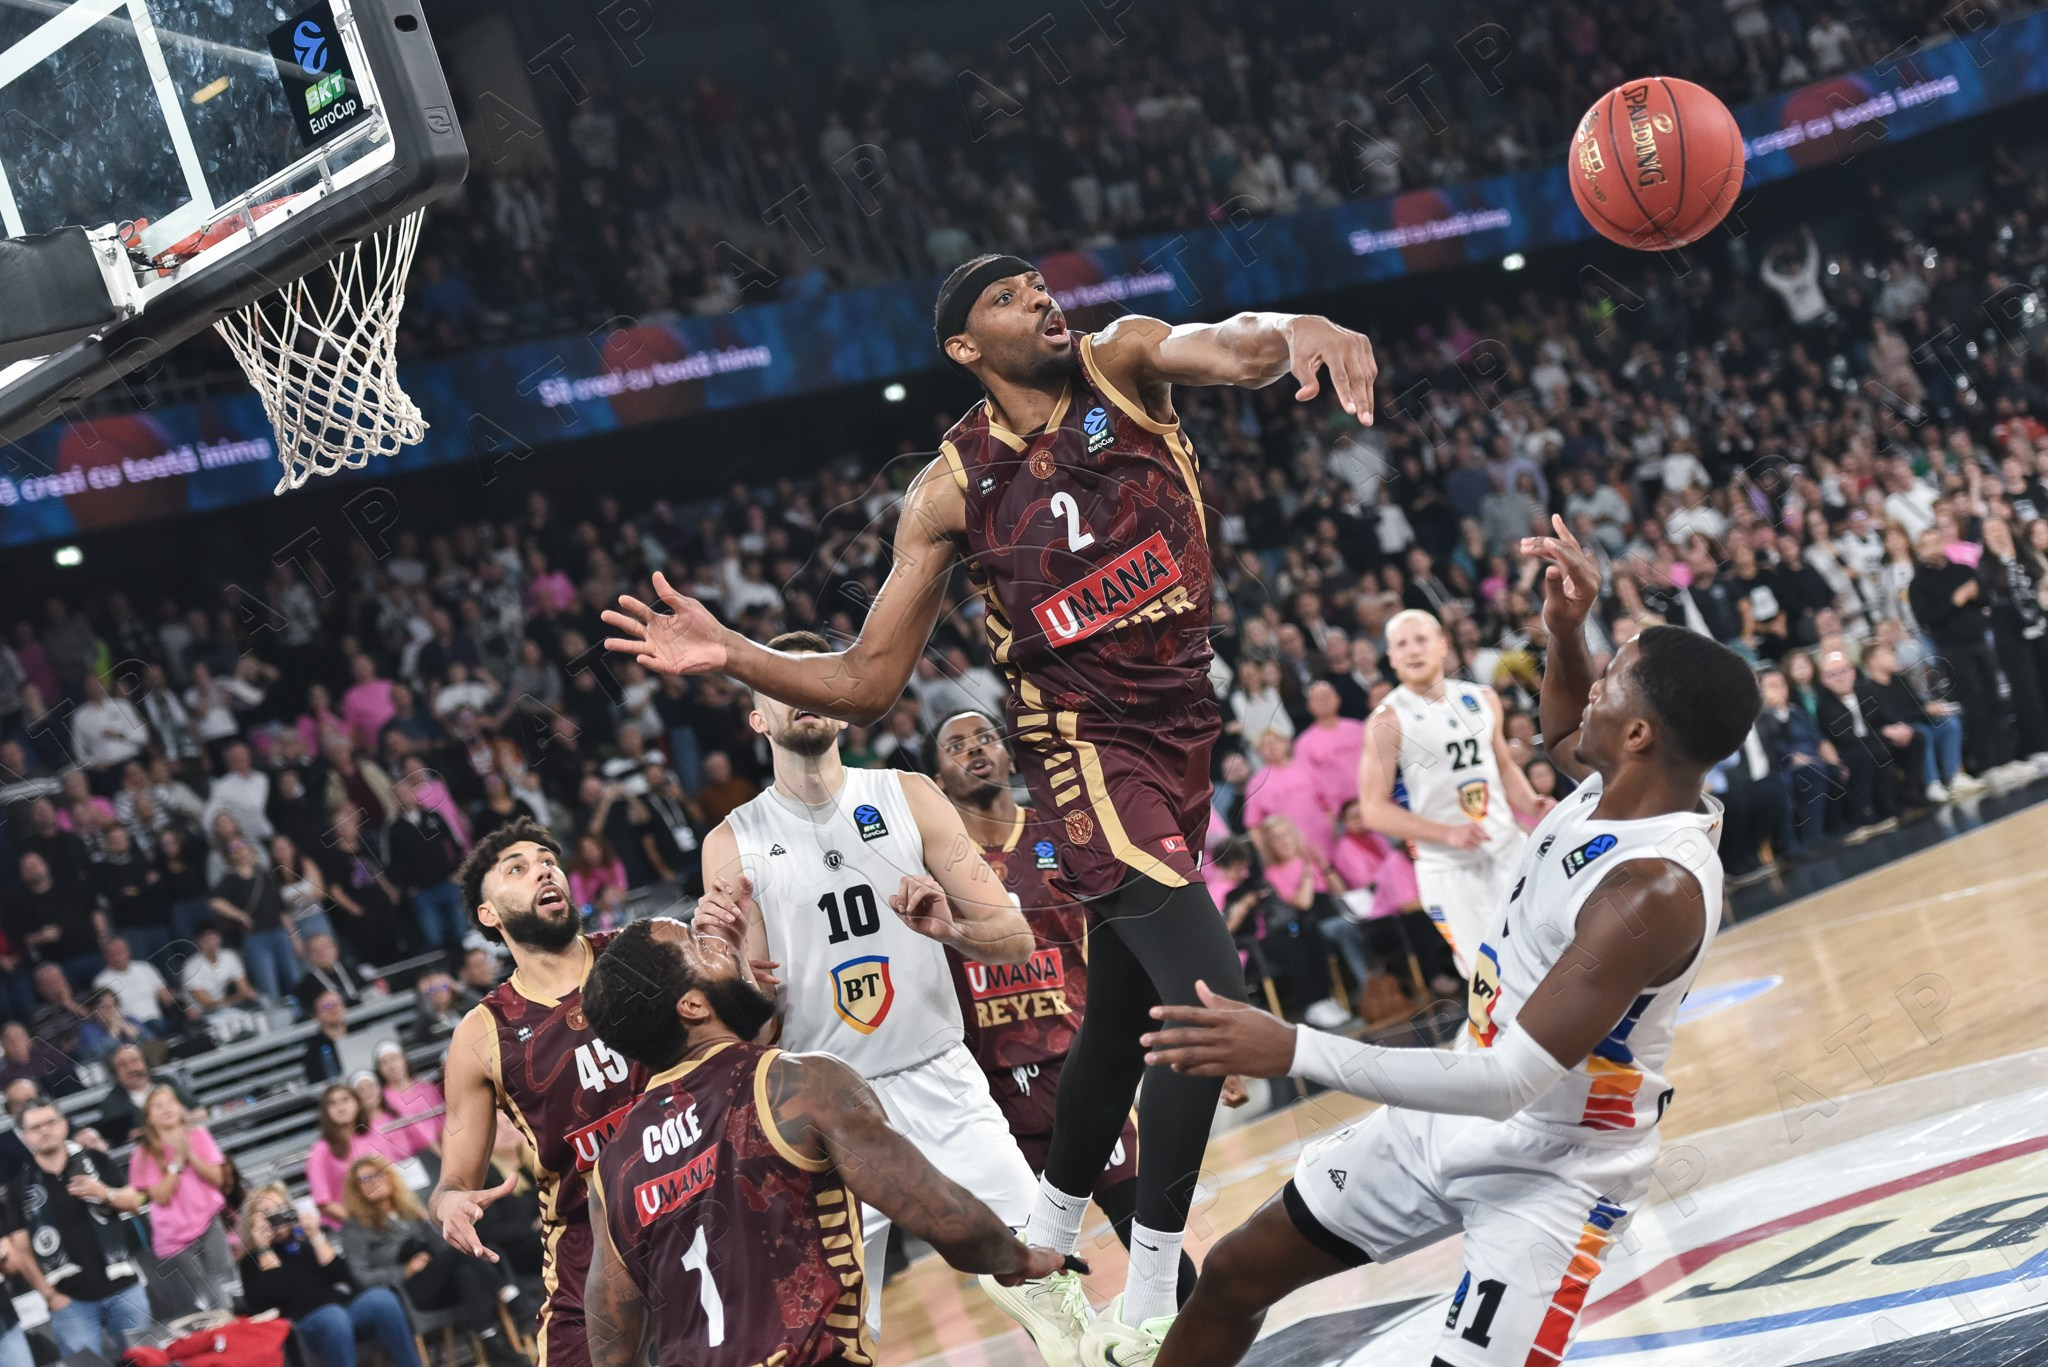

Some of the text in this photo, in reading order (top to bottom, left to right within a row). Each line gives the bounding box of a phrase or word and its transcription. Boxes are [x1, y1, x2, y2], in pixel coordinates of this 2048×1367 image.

[305, 73, 345, 114] BKT
[309, 99, 357, 135] EuroCup
[1622, 85, 1669, 188] SPALDING
[1050, 491, 1095, 553] 2
[1045, 549, 1171, 639] UMANA
[1446, 738, 1482, 771] 22
[817, 883, 881, 945] 10
[843, 973, 880, 1003] BT
[968, 957, 1058, 994] UMANA
[974, 989, 1073, 1029] REYER
[574, 1037, 629, 1093] 45
[642, 1102, 703, 1163] COLE
[640, 1155, 716, 1215] UMANA
[1327, 1168, 1345, 1193] PEAK
[680, 1224, 725, 1348] 1
[1461, 1278, 1508, 1350] 1
